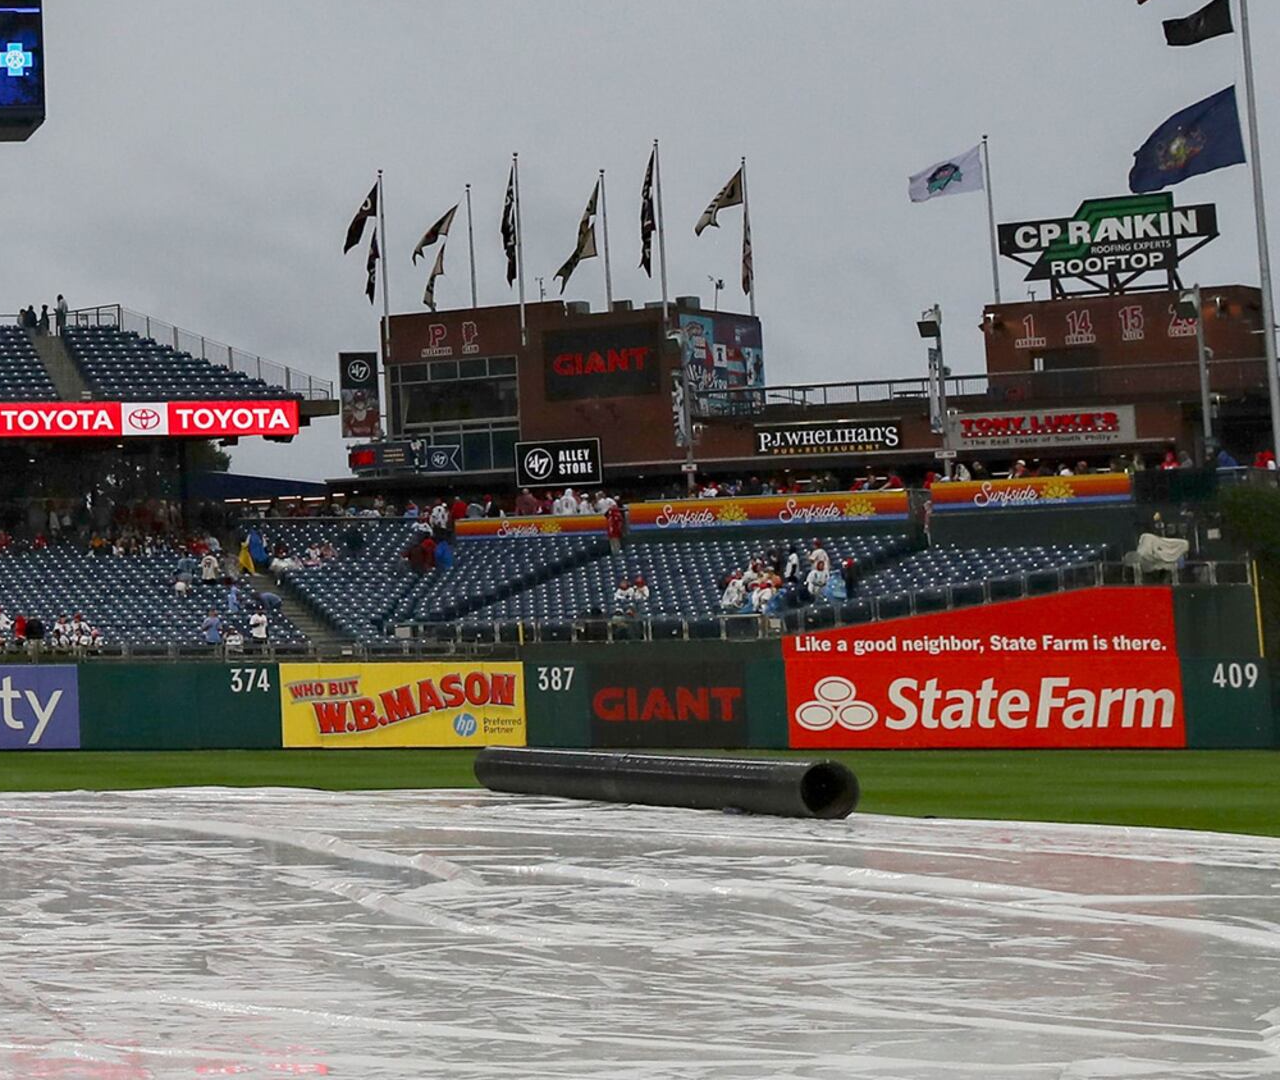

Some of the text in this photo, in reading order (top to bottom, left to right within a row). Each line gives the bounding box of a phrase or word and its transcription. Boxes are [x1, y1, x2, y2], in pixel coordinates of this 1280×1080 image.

[1014, 209, 1199, 249] CP RANKIN
[1091, 239, 1172, 255] ROOFING EXPERTS
[1050, 252, 1165, 276] ROOFTOP
[1023, 314, 1035, 338] 1
[1066, 309, 1093, 336] 14
[1119, 305, 1144, 331] 15
[552, 346, 651, 377] GIANT
[0, 409, 114, 432] TOYOTA
[175, 407, 290, 430] TOYOTA
[960, 411, 1118, 433] TONY LUKE'S
[558, 448, 591, 461] ALLEY
[773, 443, 880, 455] PUB RESTAURANT
[558, 461, 593, 475] STORE
[974, 480, 1038, 507] Surfside
[656, 504, 715, 528] Surfside
[778, 498, 841, 523] Surfside
[795, 634, 1167, 655] Like a good neighbor, State Farm is there.
[230, 667, 271, 693] 374
[538, 666, 575, 692] 387
[1212, 663, 1259, 689] 409
[289, 678, 360, 699] WHO BUT
[593, 686, 743, 722] GIANT
[885, 676, 1176, 730] State Farm
[456, 713, 475, 737] hp
[483, 716, 522, 726] Preferred
[483, 725, 514, 734] Partner
